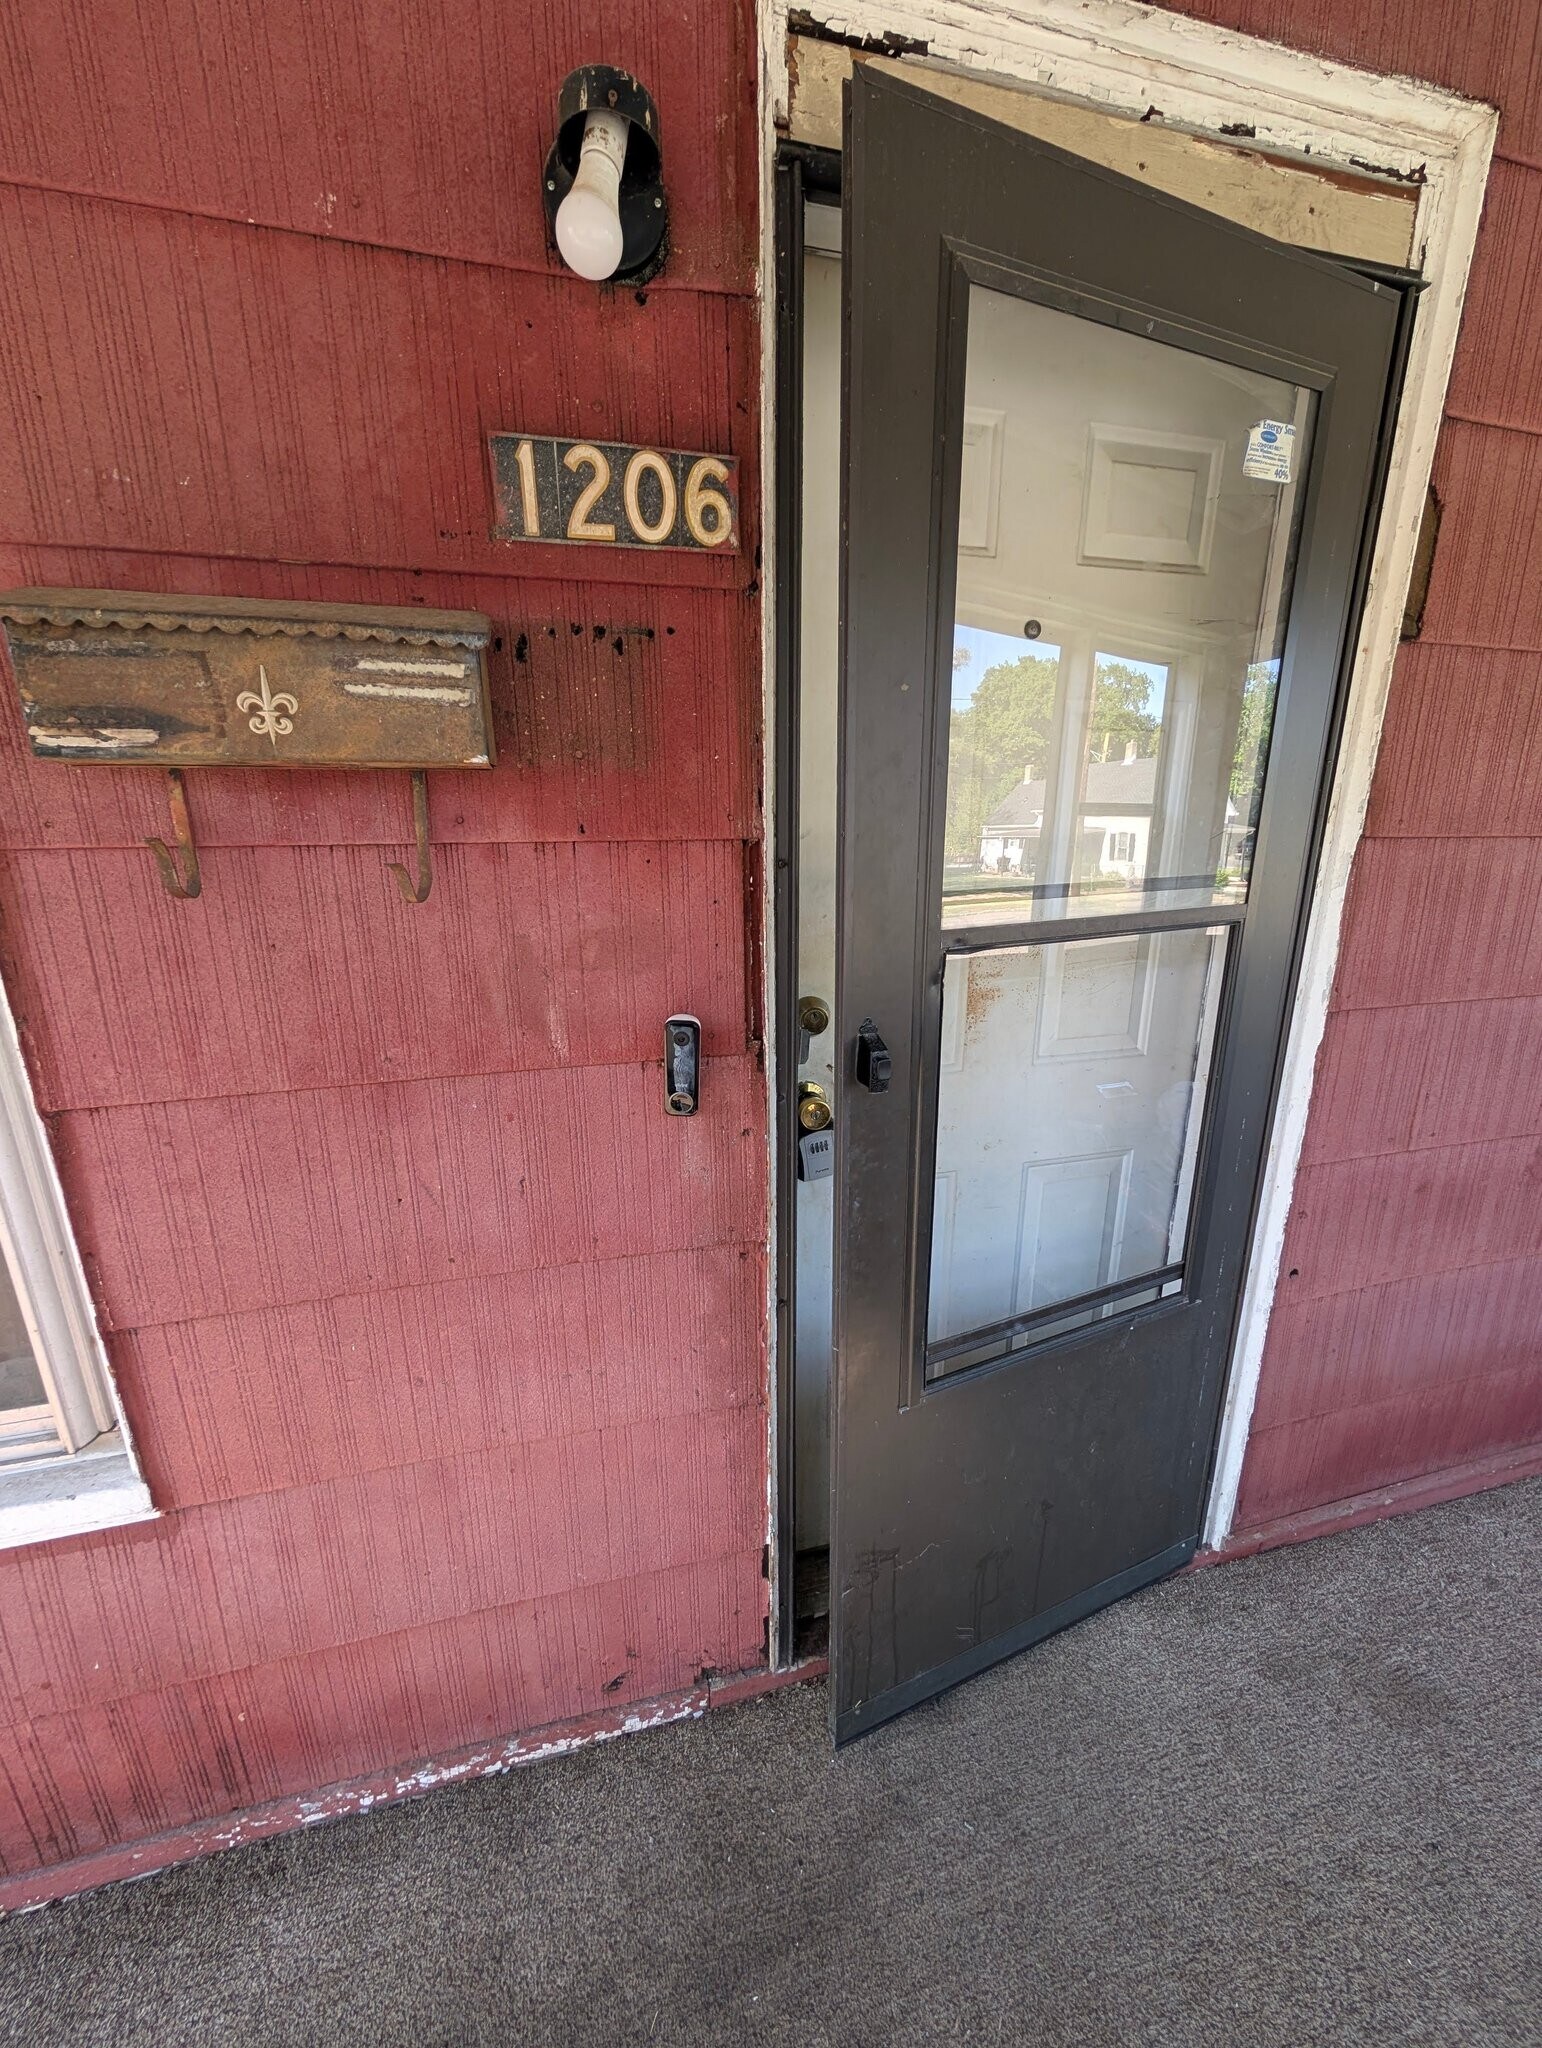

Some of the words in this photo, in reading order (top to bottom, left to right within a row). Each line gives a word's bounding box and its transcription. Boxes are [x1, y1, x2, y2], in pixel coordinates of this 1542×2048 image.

[1263, 420, 1283, 435] Energy
[1274, 468, 1289, 480] 40%
[515, 440, 732, 547] 1206
